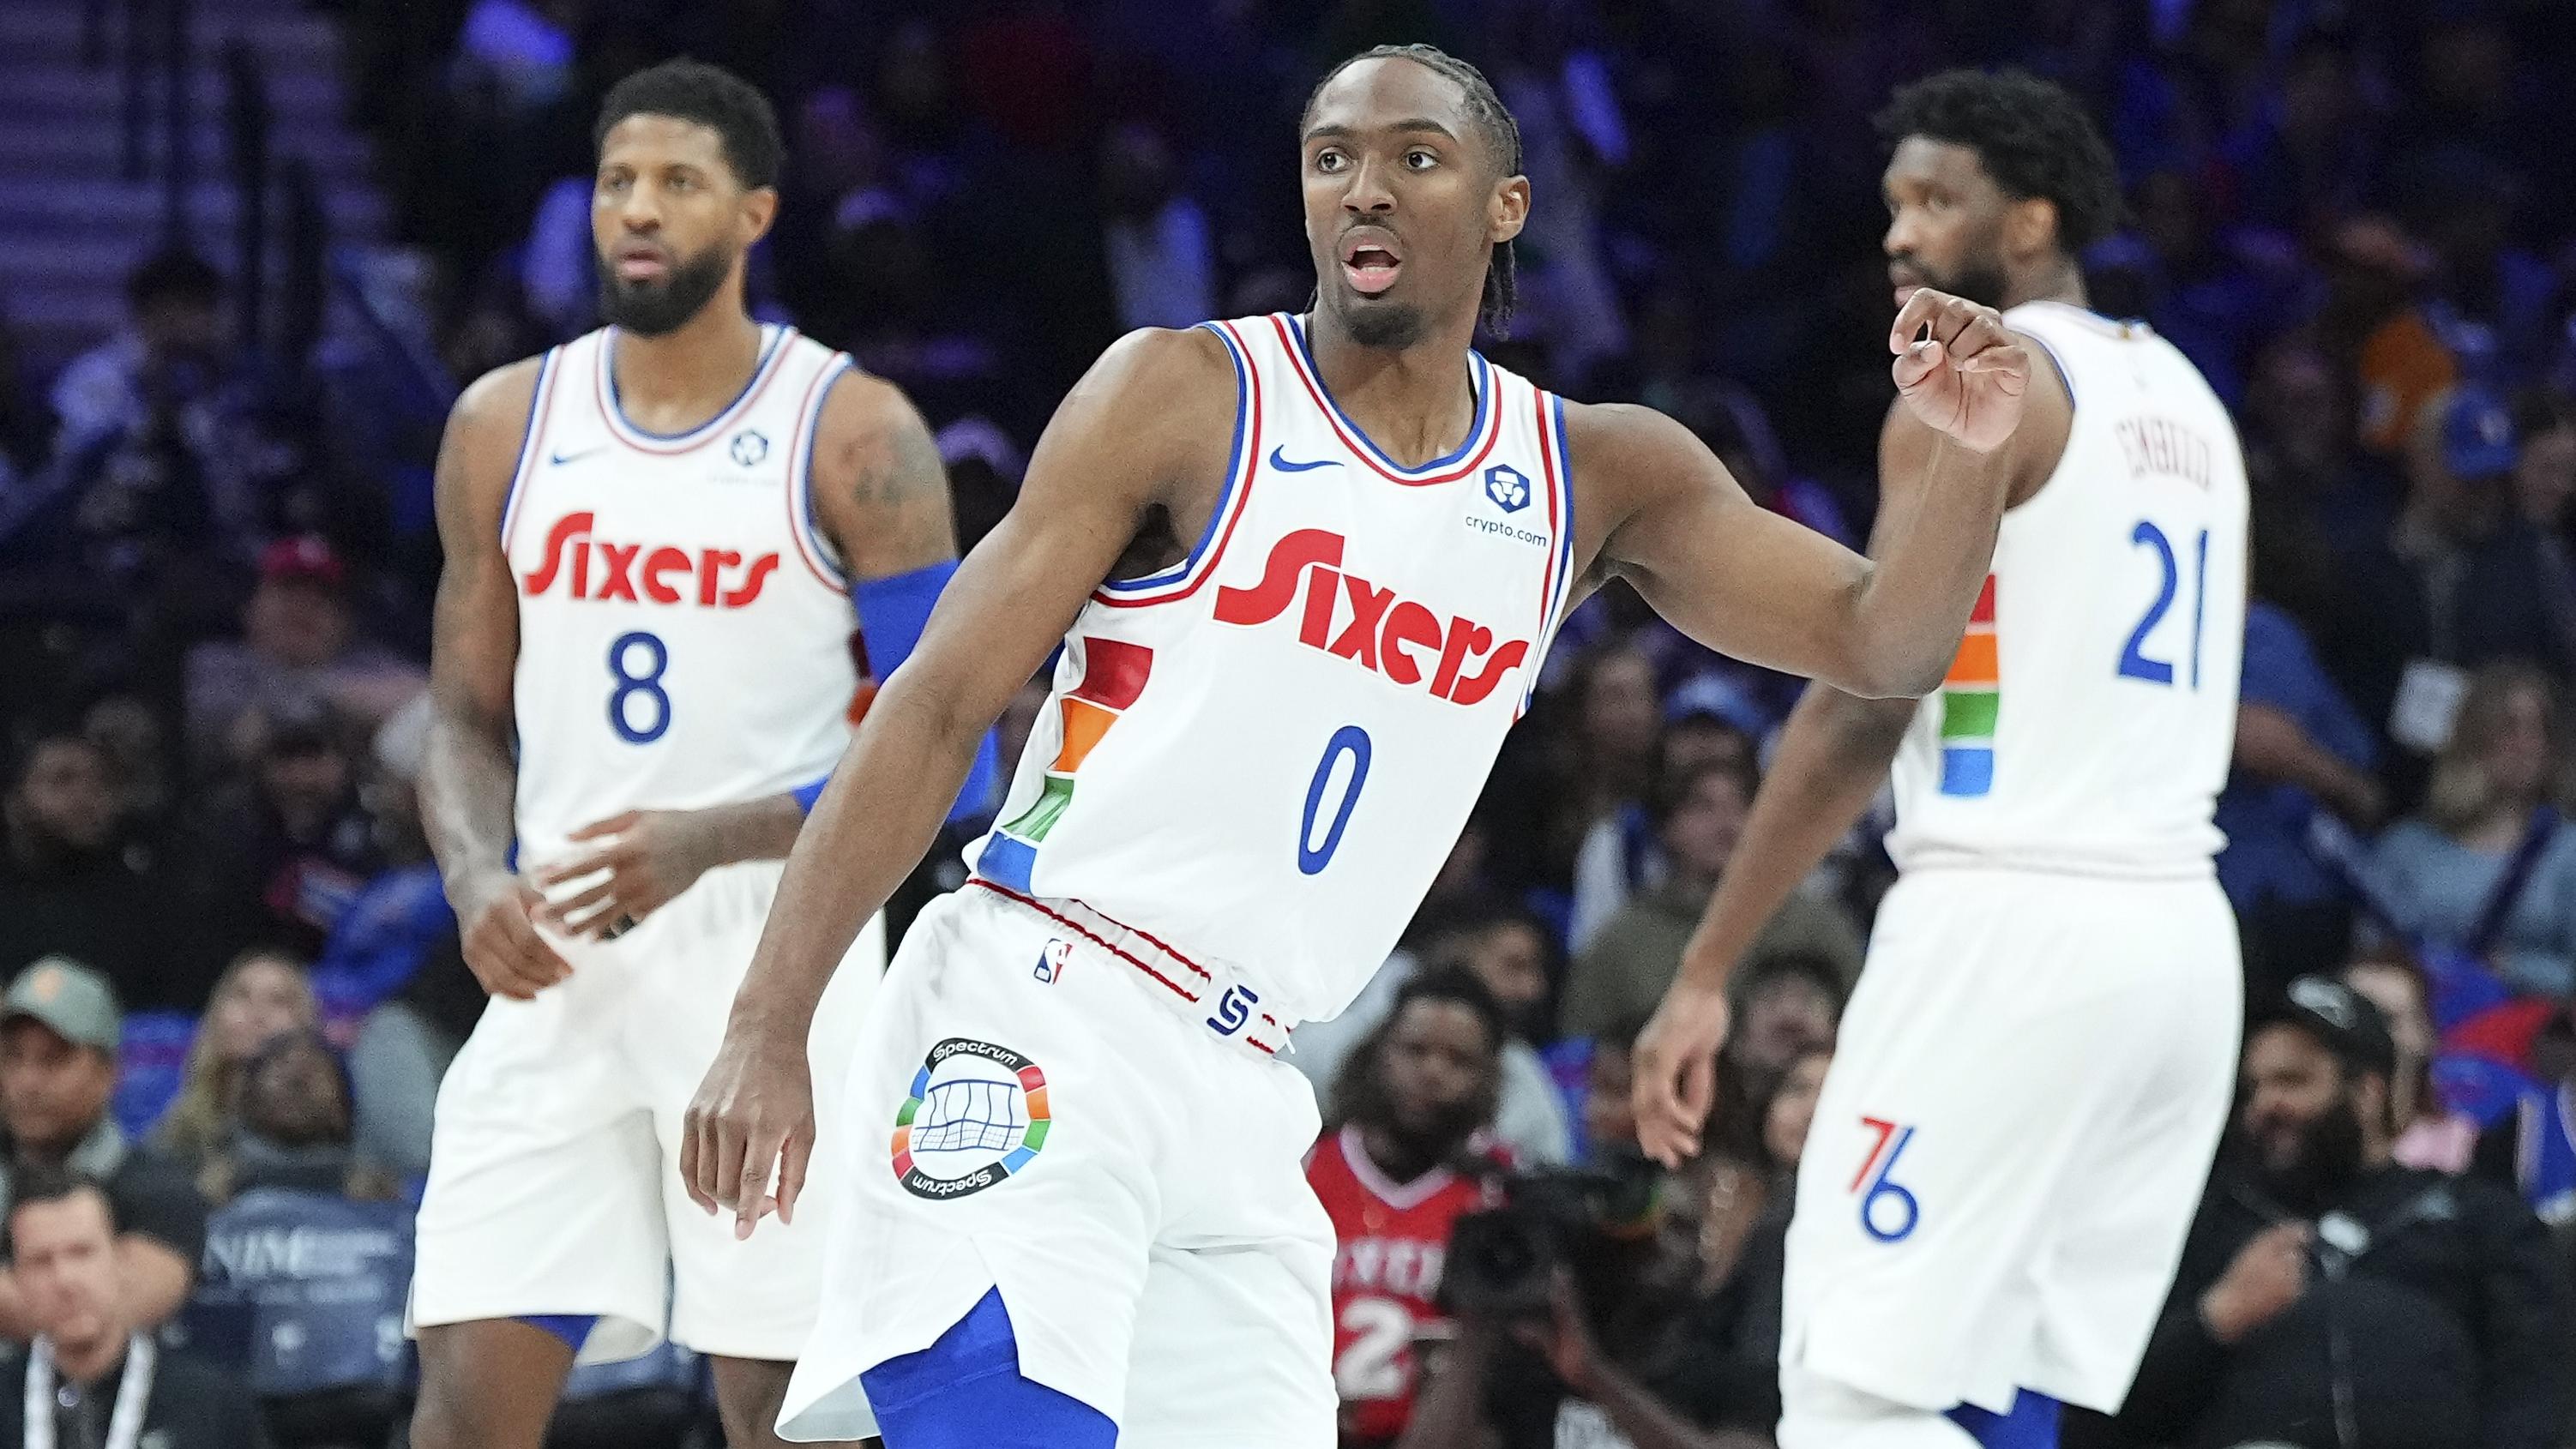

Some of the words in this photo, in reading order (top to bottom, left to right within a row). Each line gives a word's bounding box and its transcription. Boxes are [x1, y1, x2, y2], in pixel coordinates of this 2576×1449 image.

[525, 511, 779, 609] Sixers
[1465, 515, 1548, 548] crypto.com
[1213, 528, 1530, 706] Sixers
[2118, 520, 2208, 689] 21
[609, 631, 671, 744] 8
[1297, 724, 1372, 875] 0
[932, 1041, 1018, 1067] Spectrum
[912, 1169, 993, 1197] Spectrum
[1850, 1116, 1918, 1241] 76
